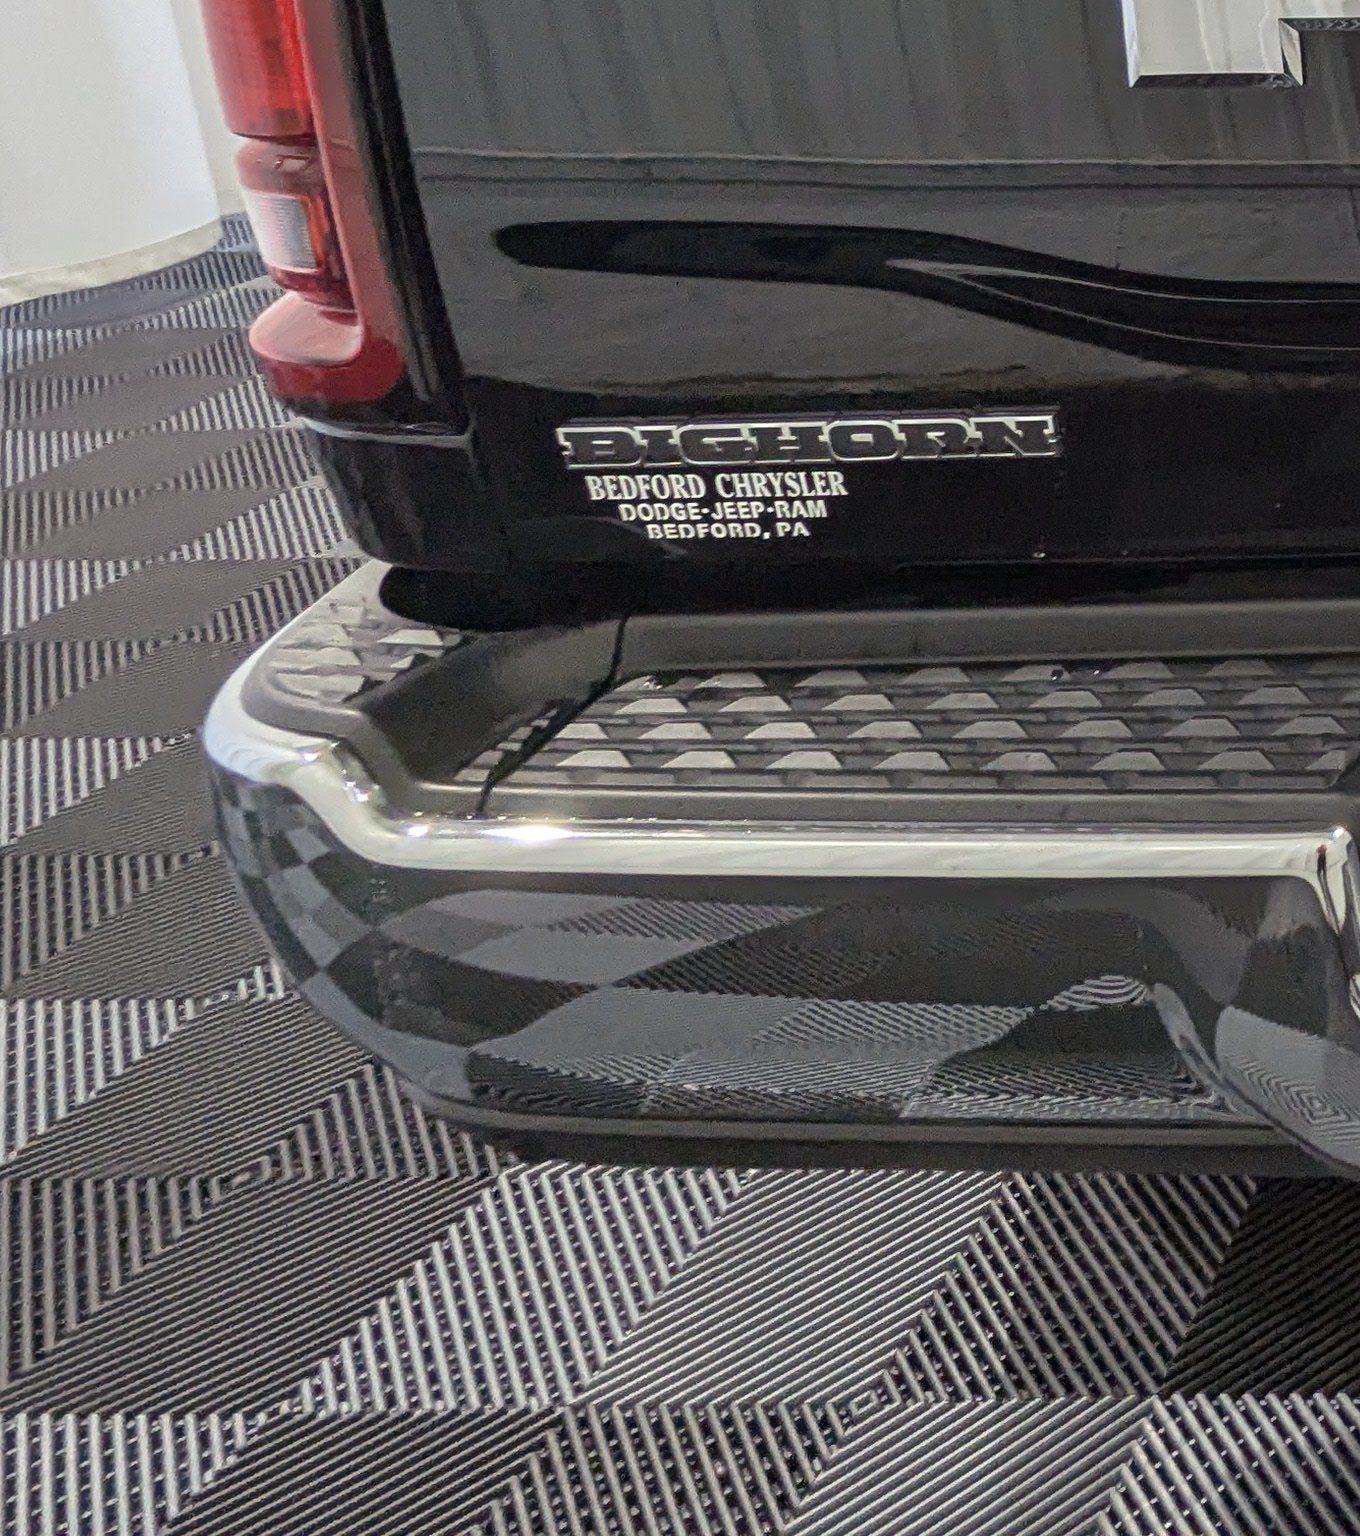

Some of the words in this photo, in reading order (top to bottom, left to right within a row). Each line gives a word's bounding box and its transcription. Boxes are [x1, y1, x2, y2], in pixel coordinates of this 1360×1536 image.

[586, 472, 706, 501] BEDFORD
[714, 470, 848, 498] CHRYSLER
[646, 521, 771, 540] BEDFORD,
[776, 521, 810, 538] PA
